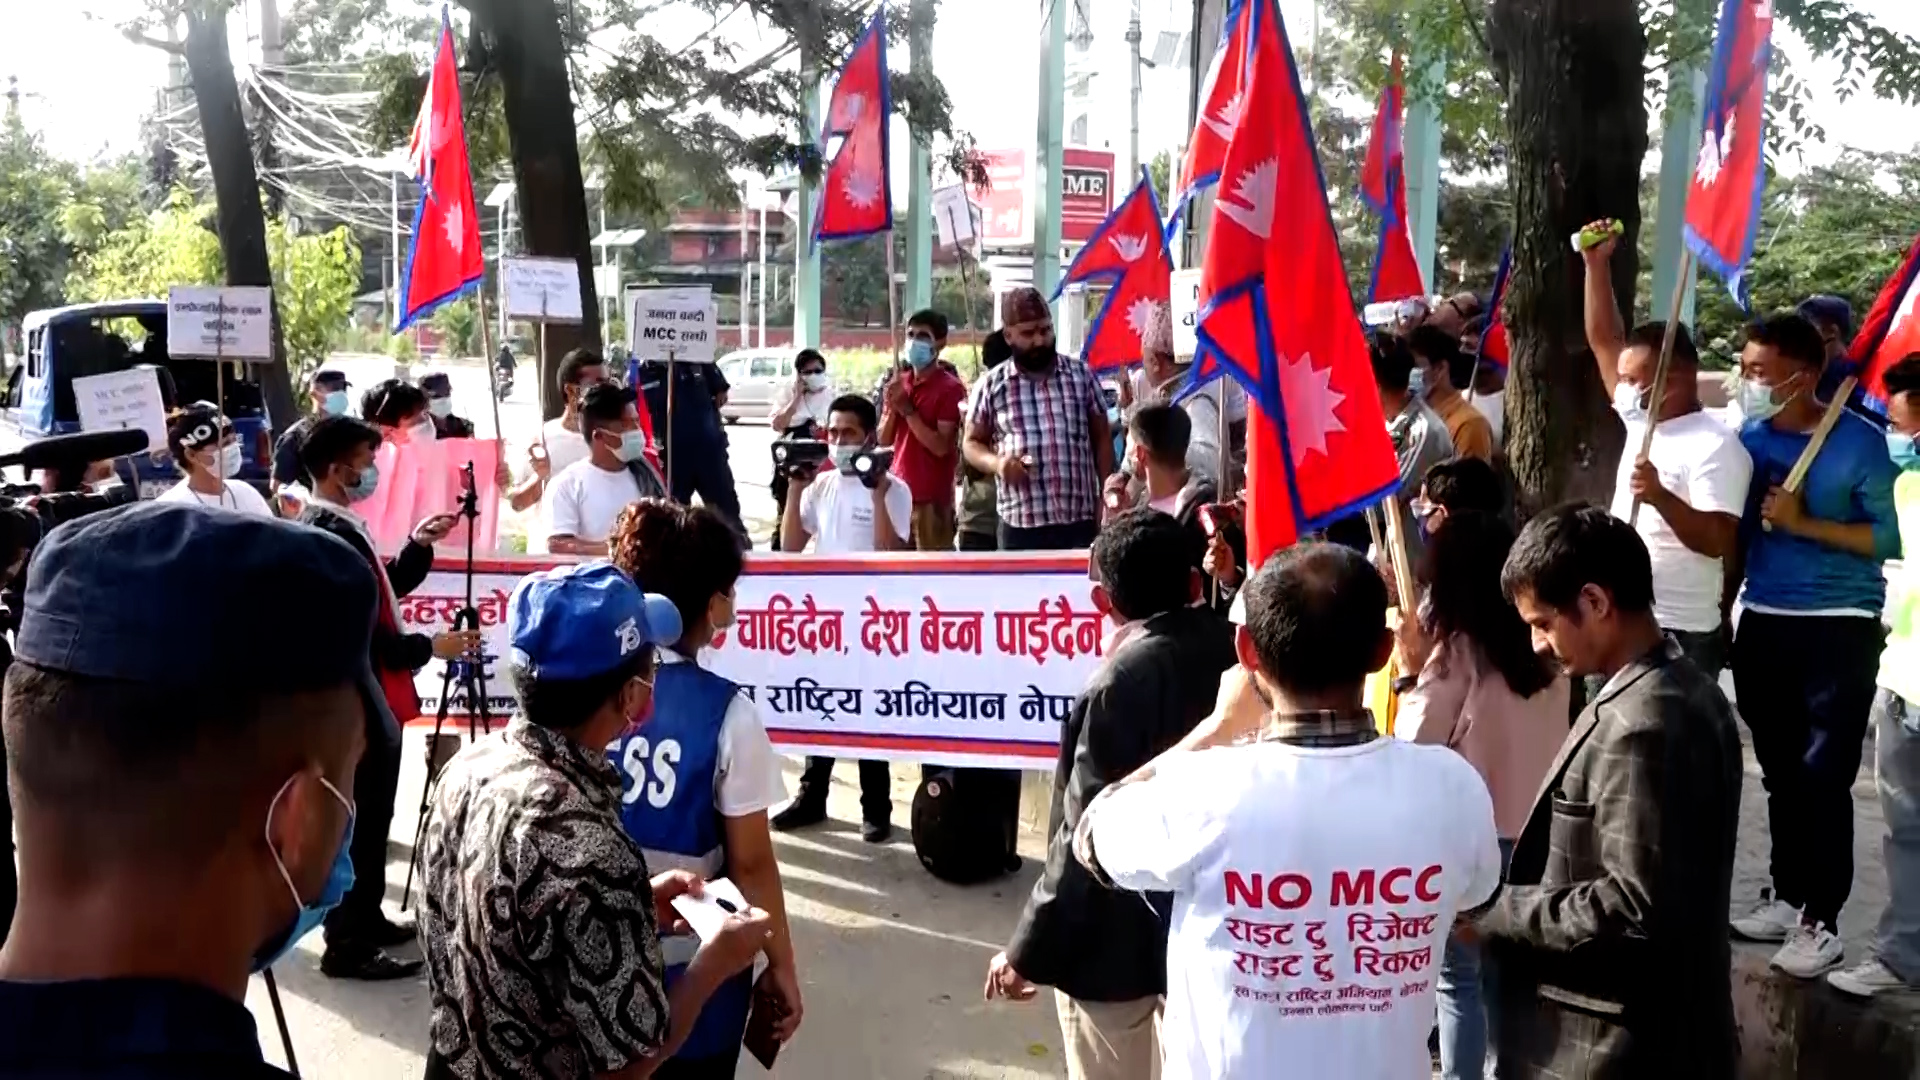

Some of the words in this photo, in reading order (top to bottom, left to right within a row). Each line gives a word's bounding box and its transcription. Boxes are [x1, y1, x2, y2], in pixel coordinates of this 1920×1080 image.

[643, 326, 677, 341] MCC
[179, 424, 212, 447] NO
[736, 594, 849, 656] चाहिदैन,
[860, 595, 911, 657] देश
[920, 595, 984, 655] बेच्न
[994, 594, 1102, 665] पाईदैन
[765, 677, 863, 721] राष्ट्रिय
[874, 680, 1008, 721] अभियान
[1019, 684, 1076, 723] नेप
[1224, 869, 1312, 909] NO
[1329, 864, 1443, 908] MCC
[1224, 917, 1295, 948] राइट
[1304, 921, 1327, 950] टु
[1347, 911, 1439, 943] रिजेक्ट
[1233, 950, 1304, 979] राइट
[1313, 953, 1334, 982] टु
[1354, 945, 1431, 976] रिकल
[1337, 983, 1393, 999] अभियान
